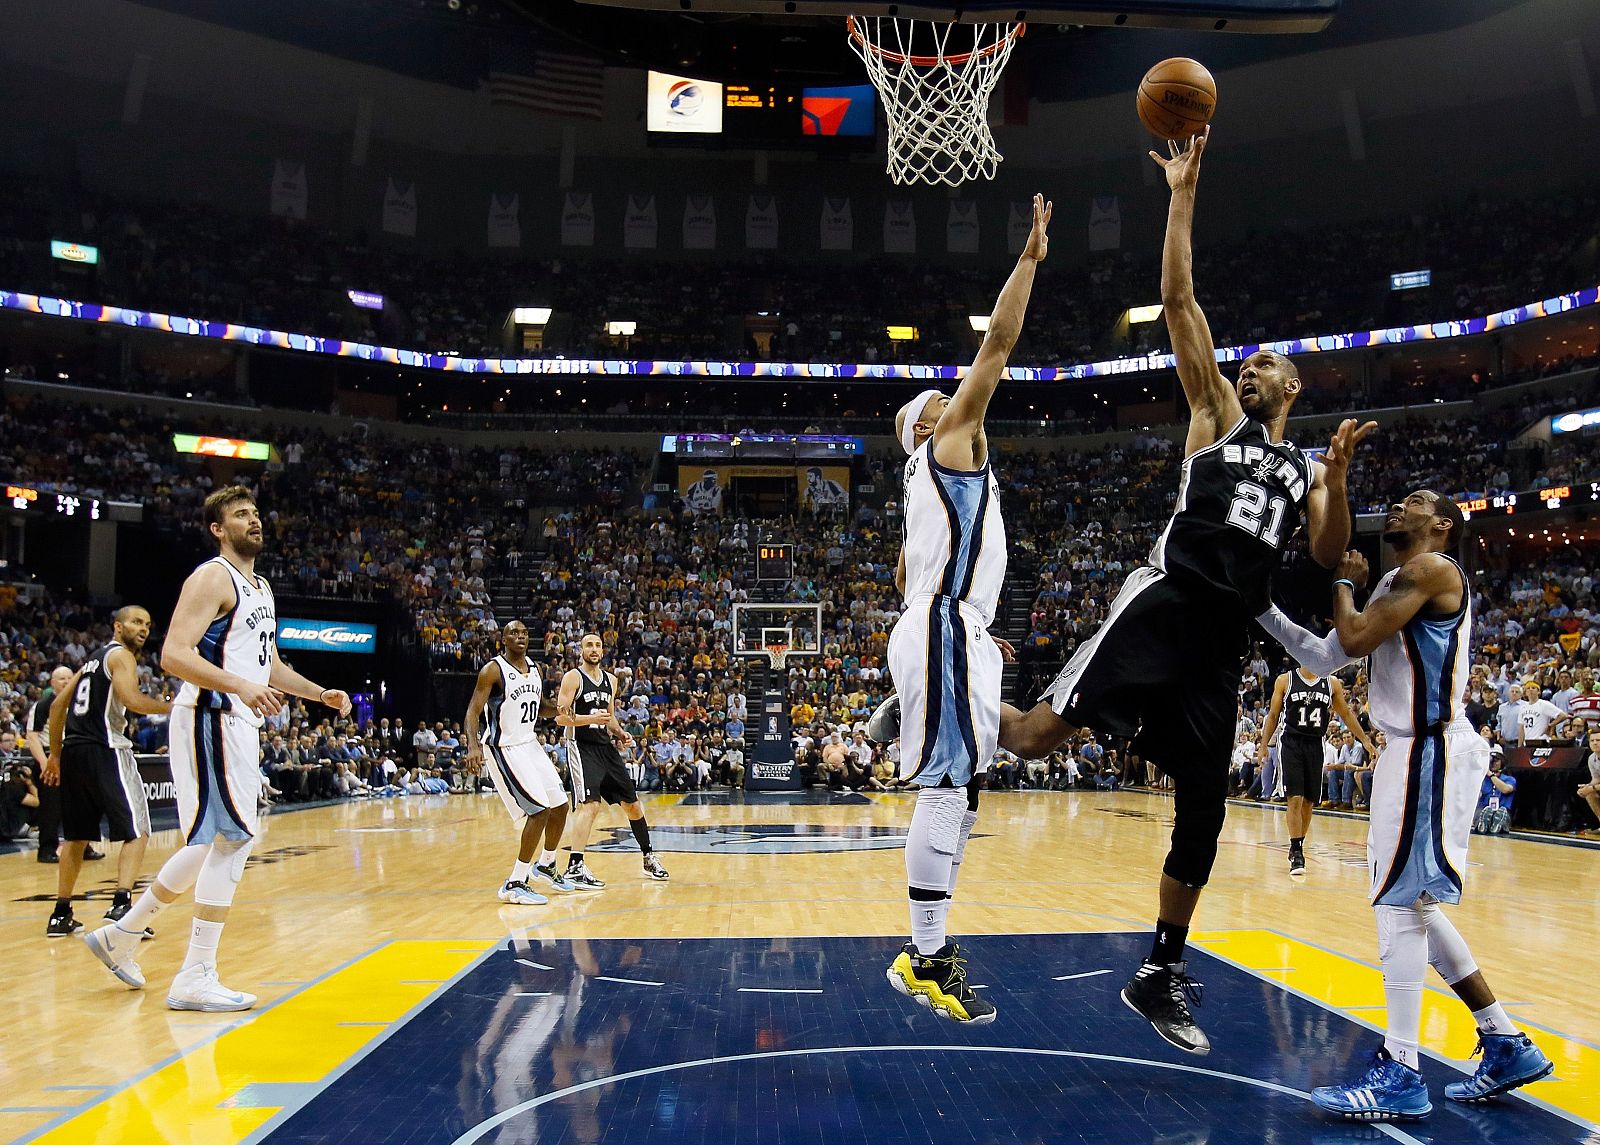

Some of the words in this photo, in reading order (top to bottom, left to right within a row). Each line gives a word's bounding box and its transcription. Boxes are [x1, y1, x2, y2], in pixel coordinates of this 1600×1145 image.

[1163, 90, 1212, 117] SPALDING
[517, 359, 590, 374] DEFENSE
[1103, 354, 1167, 376] DEFENSE
[1222, 444, 1305, 503] SPURS
[1540, 486, 1570, 500] SPURS
[1225, 479, 1288, 550] 21
[280, 627, 320, 641] BUD
[328, 631, 373, 644] LIGHT
[74, 677, 91, 717] 9
[1291, 691, 1330, 706] SPURS
[521, 701, 538, 724] 20
[1297, 706, 1322, 728] 14
[1533, 748, 1552, 757] ESPN
